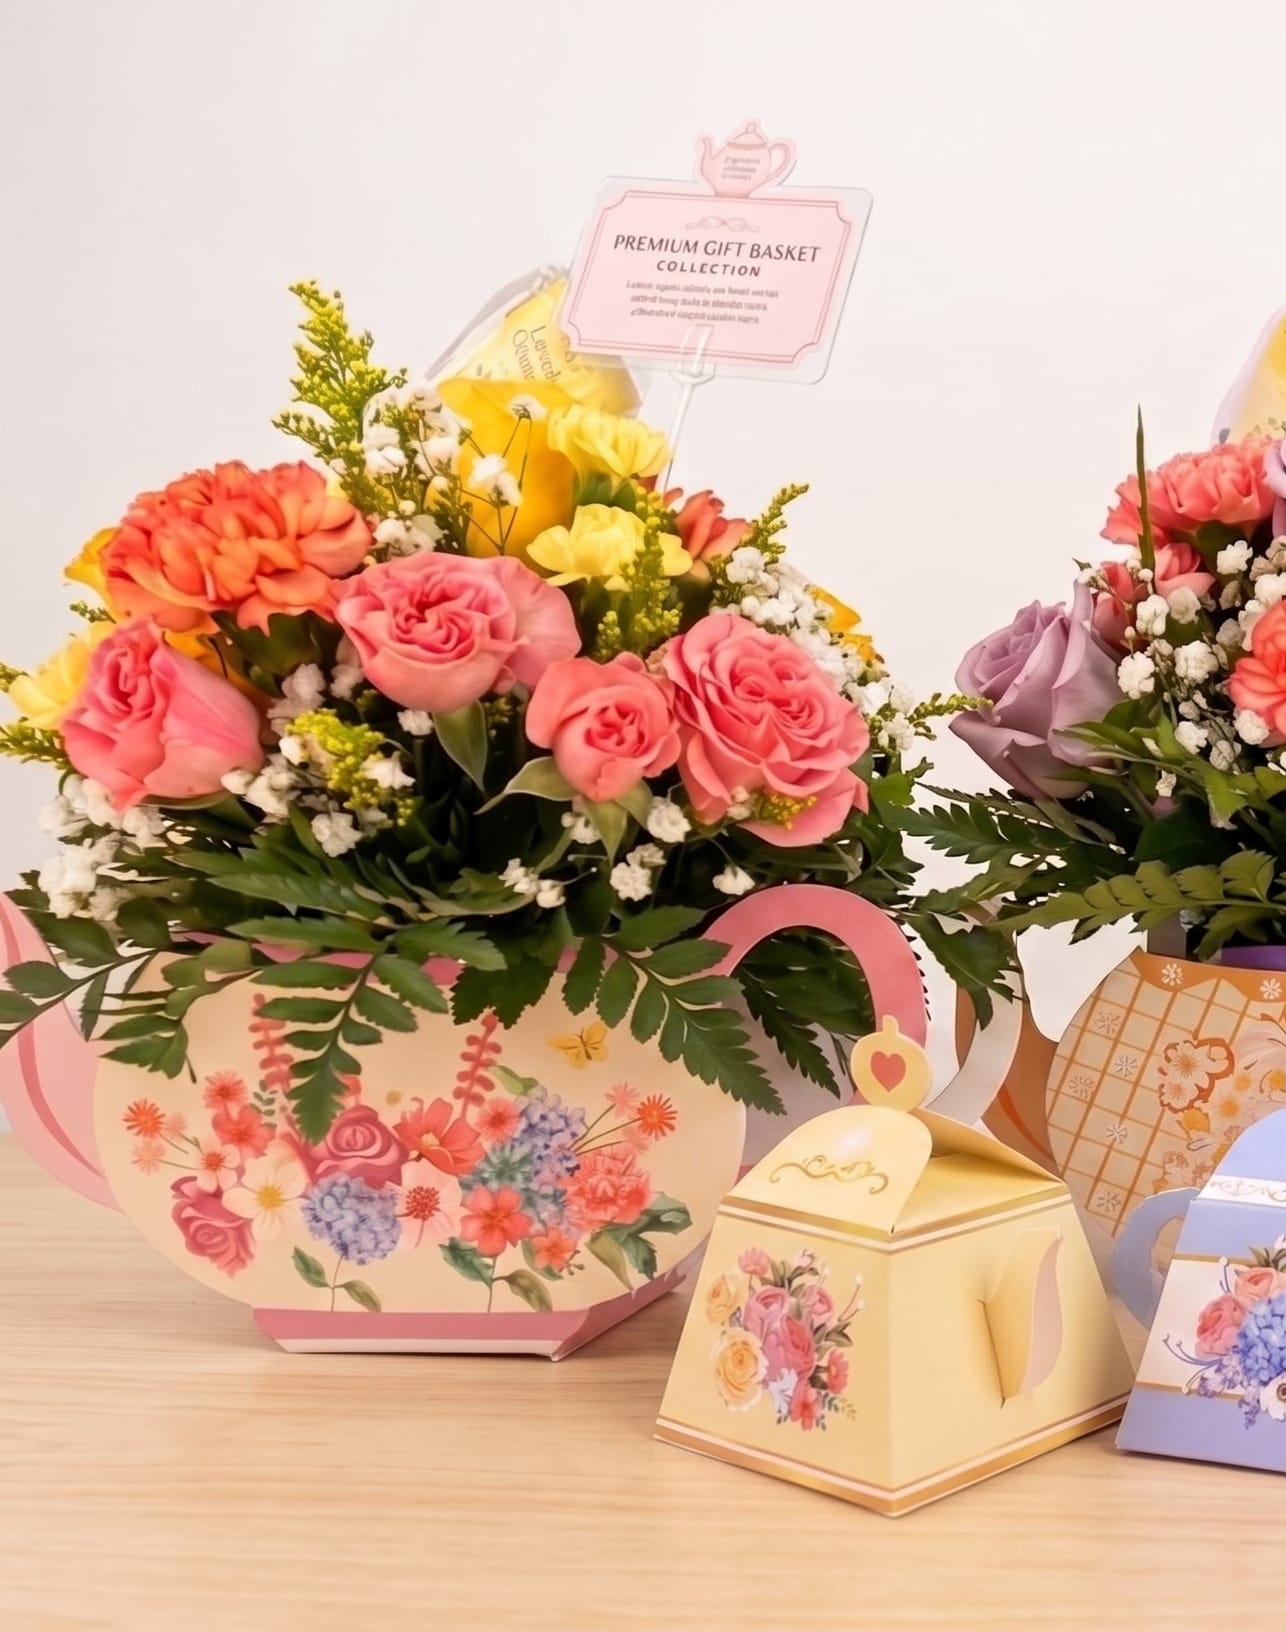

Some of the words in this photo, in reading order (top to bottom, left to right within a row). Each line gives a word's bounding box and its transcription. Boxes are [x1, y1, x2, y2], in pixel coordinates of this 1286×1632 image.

[613, 234, 698, 255] PREMIUM
[704, 240, 747, 258] GIFT
[750, 242, 822, 262] BASKET
[656, 260, 761, 277] COLLECTION
